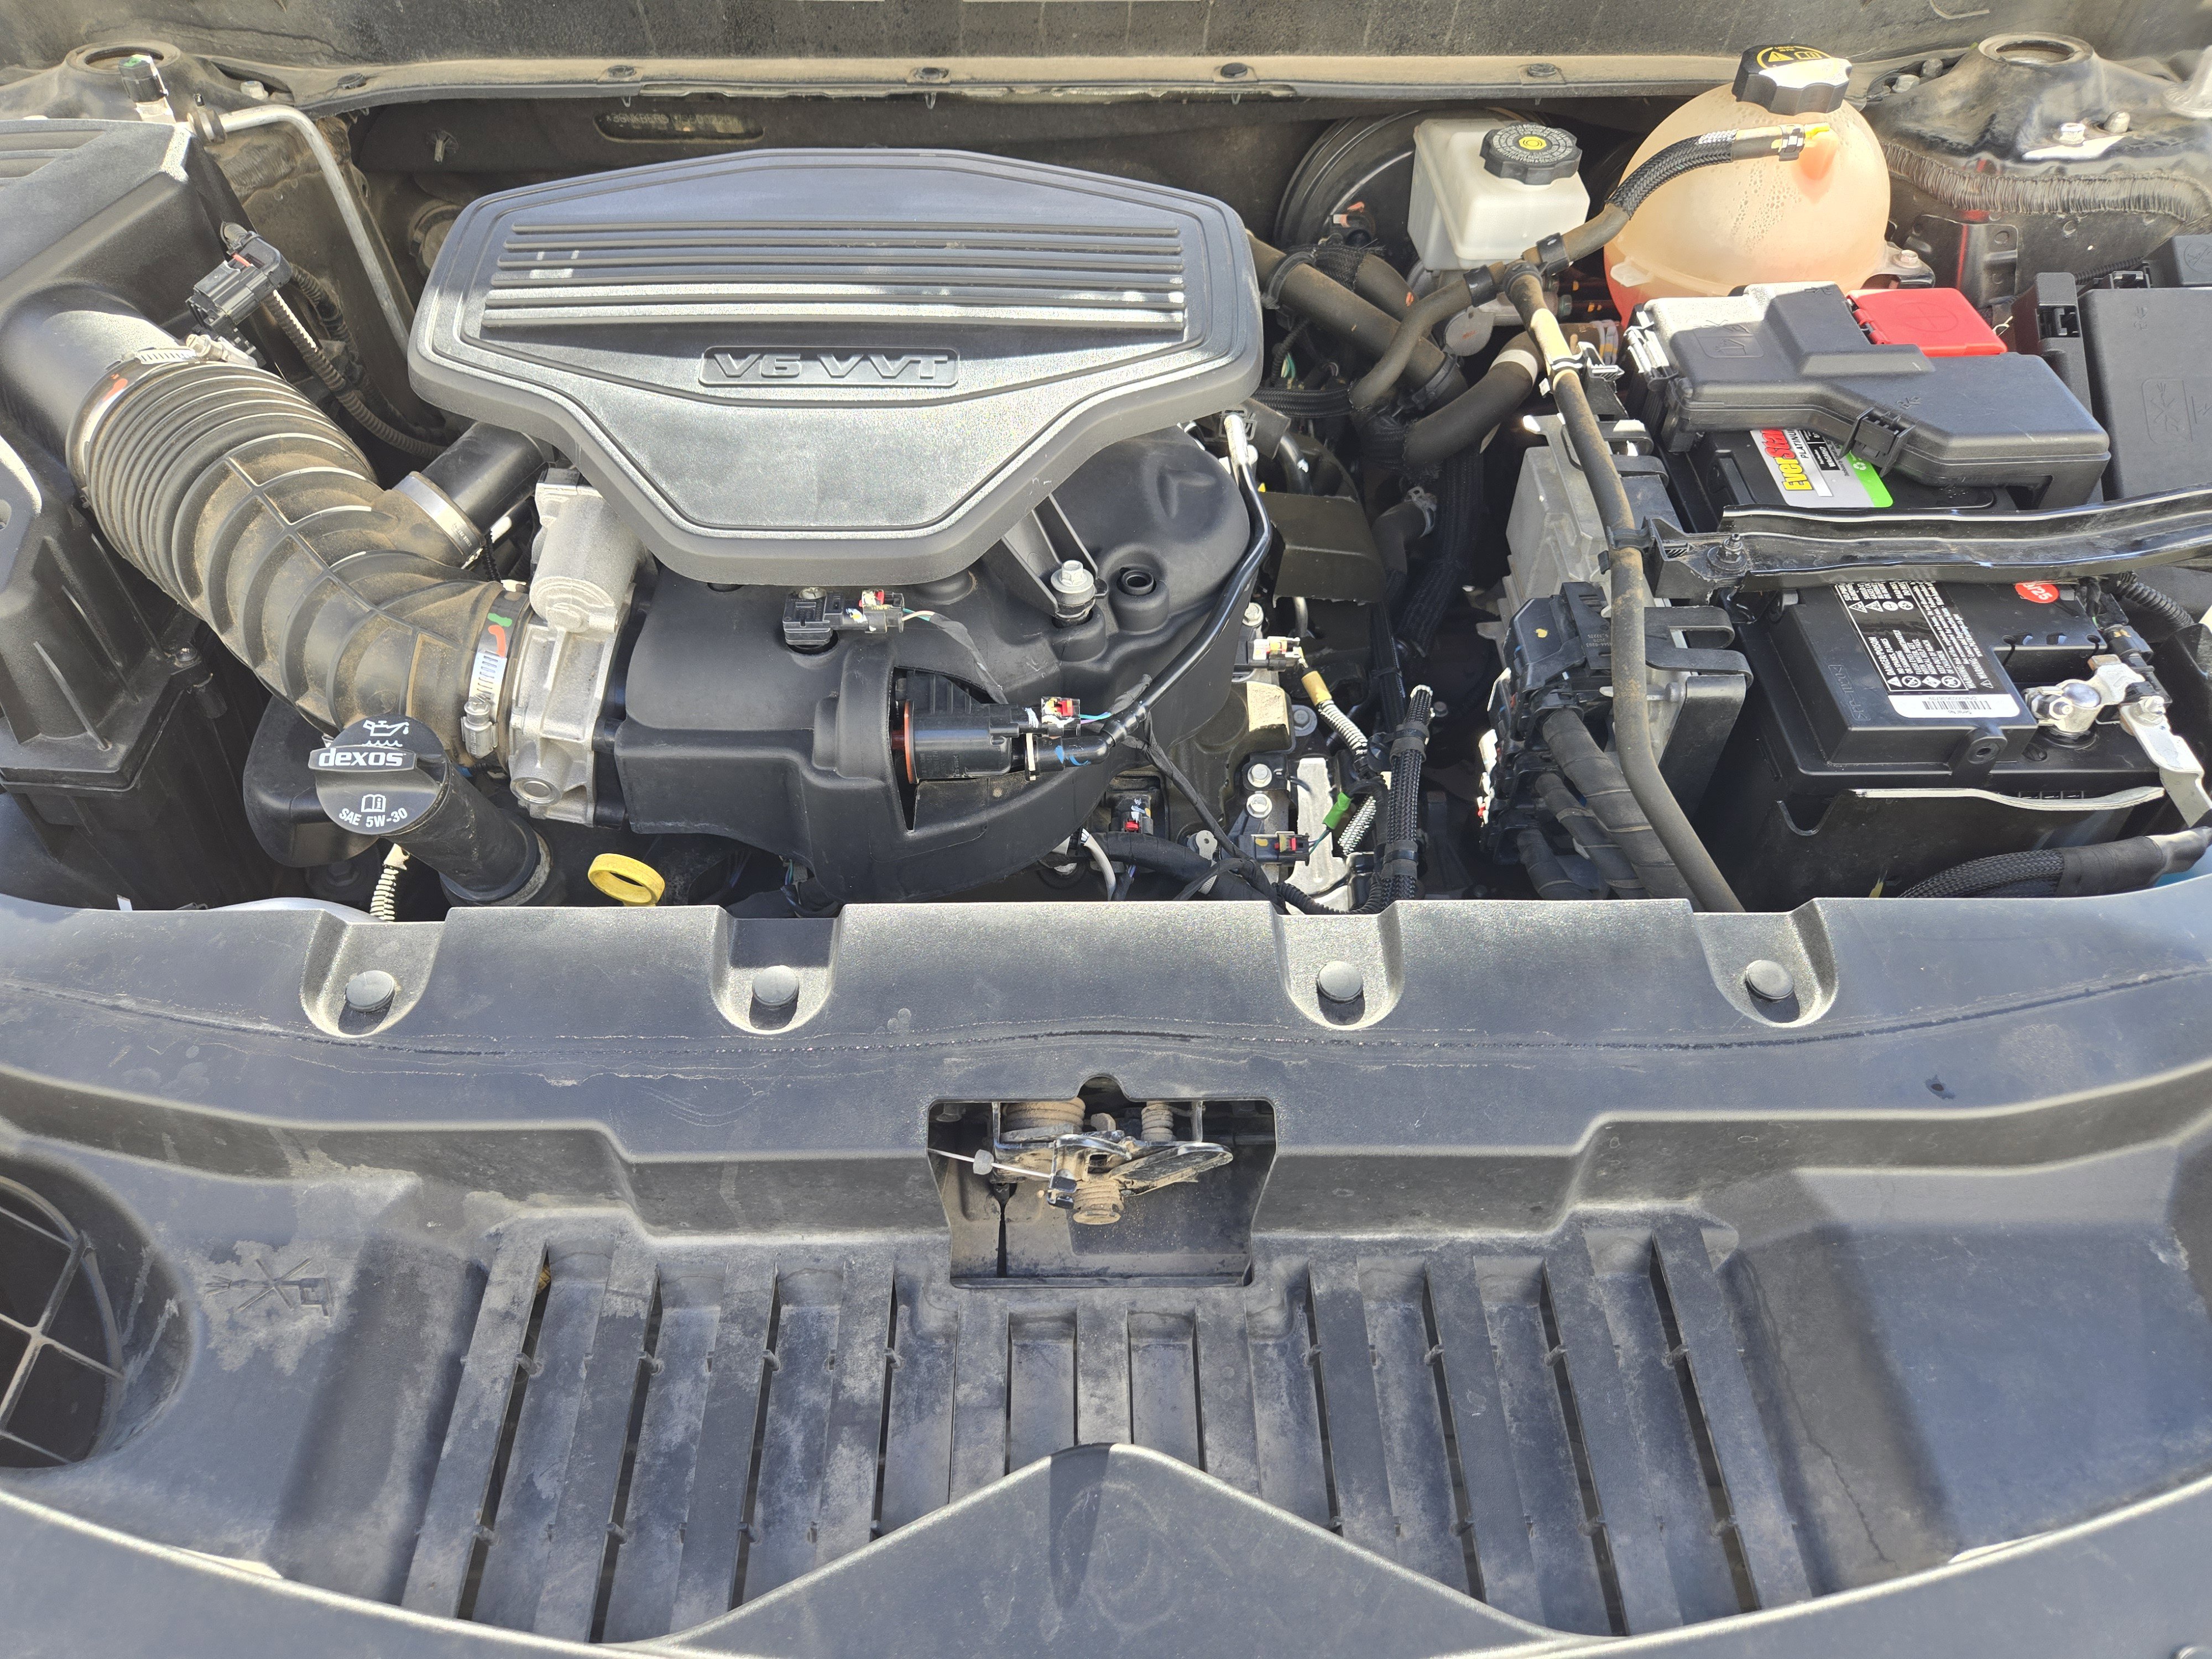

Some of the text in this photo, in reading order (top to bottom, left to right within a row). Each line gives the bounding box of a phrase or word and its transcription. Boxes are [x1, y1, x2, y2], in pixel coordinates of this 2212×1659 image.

[714, 353, 949, 380] V6 VVT
[1786, 429, 1809, 458] PLATINU
[1947, 617, 1965, 638] Reproductive
[1953, 614, 1982, 656] www.P65Warnings.ca.gov
[1880, 638, 1893, 653] FLAMES
[1892, 629, 1922, 674] FLUSH EYES IMMEDIATELY
[1917, 648, 1928, 658] HELP
[1922, 639, 1933, 651] REACH
[1947, 634, 1965, 658] recommended
[1963, 645, 1974, 657] Cancer
[1868, 637, 1895, 675] DANGER/POISON
[1895, 650, 1910, 667] SMOKING
[1936, 650, 1951, 668] CHILDREN
[1919, 664, 1929, 674] WITH
[1923, 658, 1937, 674] MEDICAL
[1936, 664, 1946, 674] KEEP
[1968, 658, 1987, 679] WARNING:
[1956, 664, 1976, 688] WARNING:
[319, 748, 404, 766] dexos
[338, 807, 408, 828] SAE 5W-30
